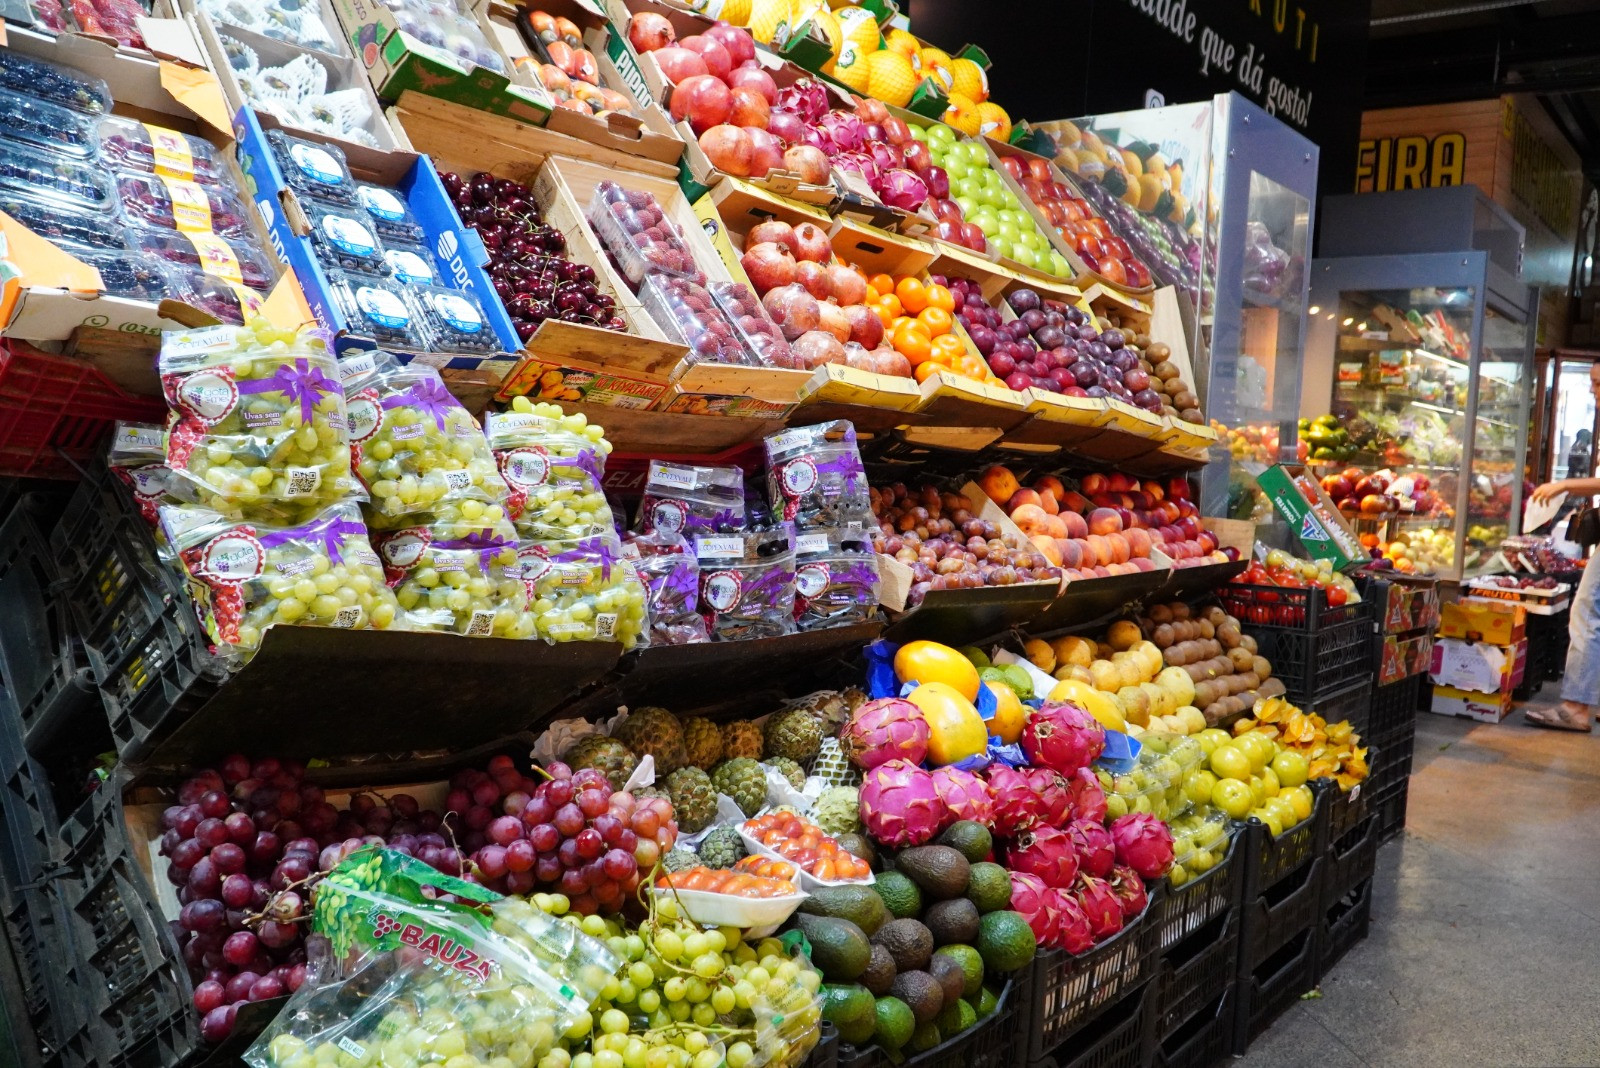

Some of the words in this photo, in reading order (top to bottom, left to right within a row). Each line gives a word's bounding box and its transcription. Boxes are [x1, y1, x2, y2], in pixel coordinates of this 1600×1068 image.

[1200, 26, 1236, 77] que
[1240, 43, 1265, 95] dá
[1266, 76, 1313, 128] gosto!
[244, 412, 263, 420] Uvas
[264, 411, 281, 419] sem
